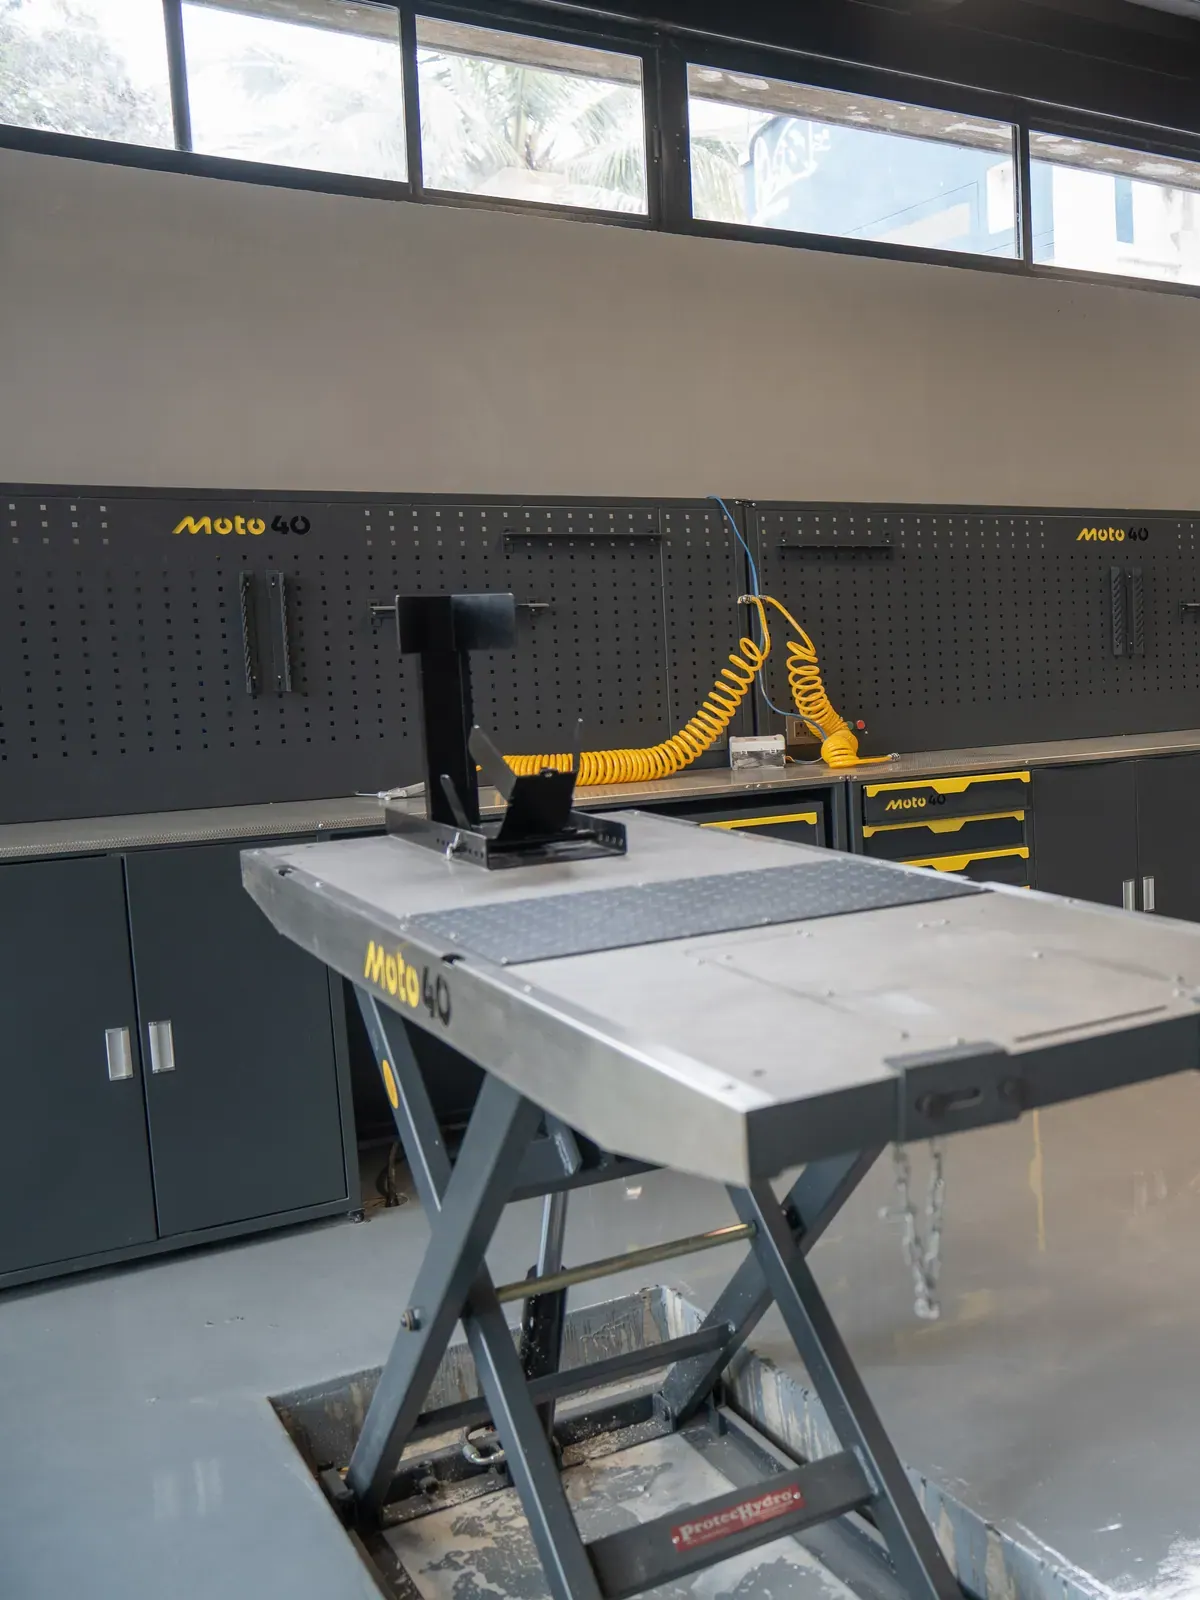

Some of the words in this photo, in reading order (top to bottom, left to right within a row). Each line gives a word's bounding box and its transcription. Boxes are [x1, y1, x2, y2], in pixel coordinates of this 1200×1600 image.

[172, 515, 266, 535] Moto
[271, 515, 311, 535] 40
[1076, 527, 1125, 541] Moto
[1128, 527, 1149, 541] 40
[885, 796, 927, 811] Moto
[363, 939, 419, 1008] Moto
[422, 964, 451, 1028] 40
